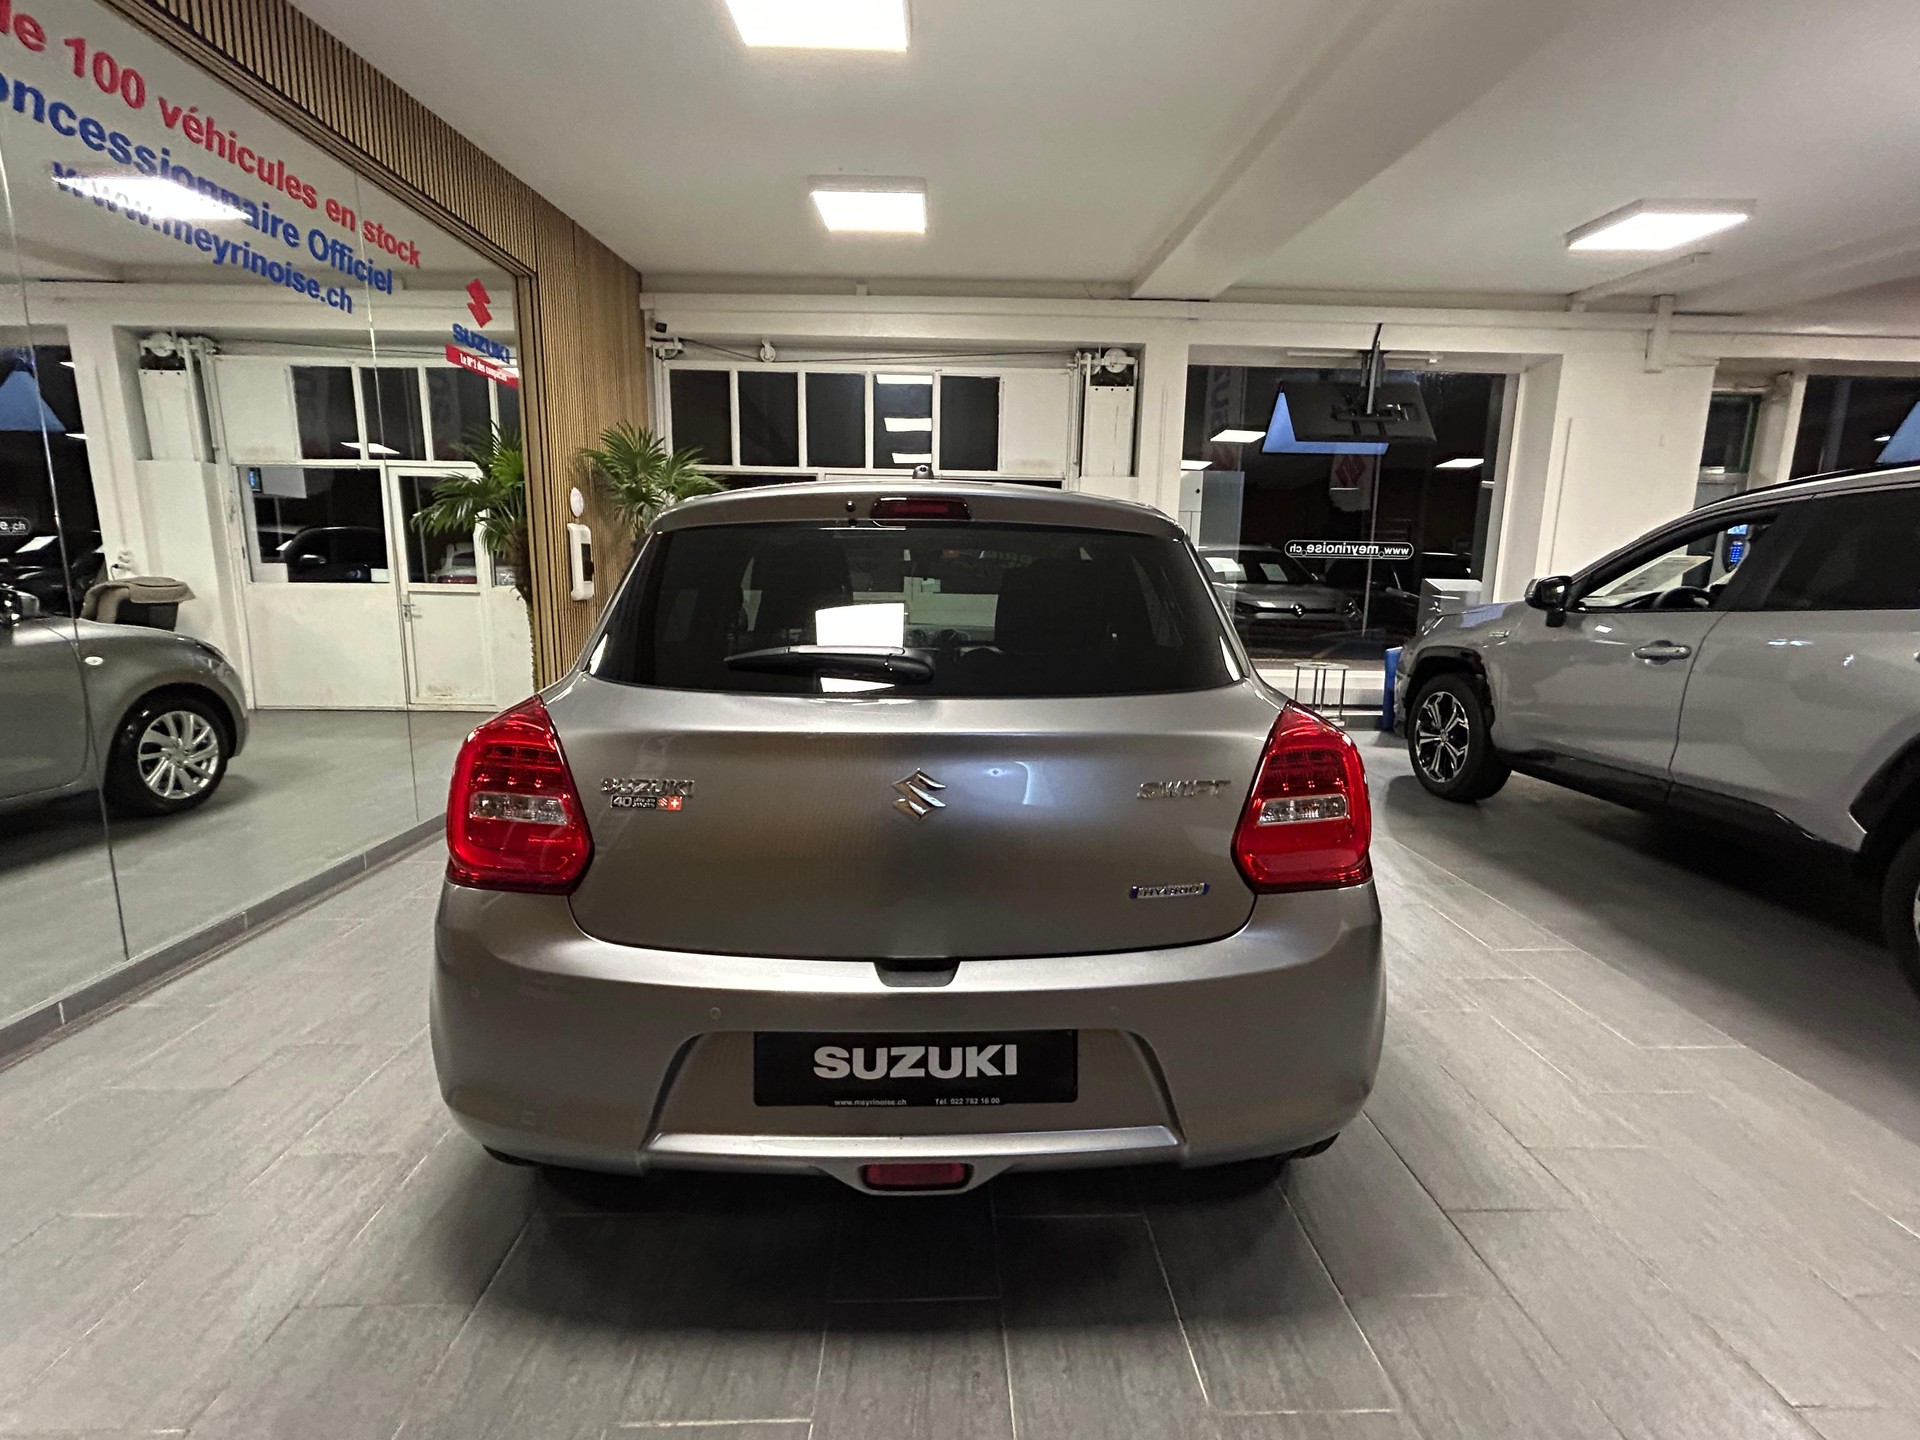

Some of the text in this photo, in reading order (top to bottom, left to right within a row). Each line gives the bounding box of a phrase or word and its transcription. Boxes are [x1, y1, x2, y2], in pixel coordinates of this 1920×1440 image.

[64, 38, 146, 109] 100
[158, 95, 318, 211] véhicules
[325, 198, 356, 232] en
[363, 219, 421, 268] stock
[308, 228, 393, 295] Officiel
[452, 323, 510, 365] SUZUKI
[600, 779, 695, 797] SUZUKI
[1137, 780, 1231, 799] SWIFT
[813, 1044, 1018, 1079] SUZUKI
[950, 1097, 964, 1105] 022
